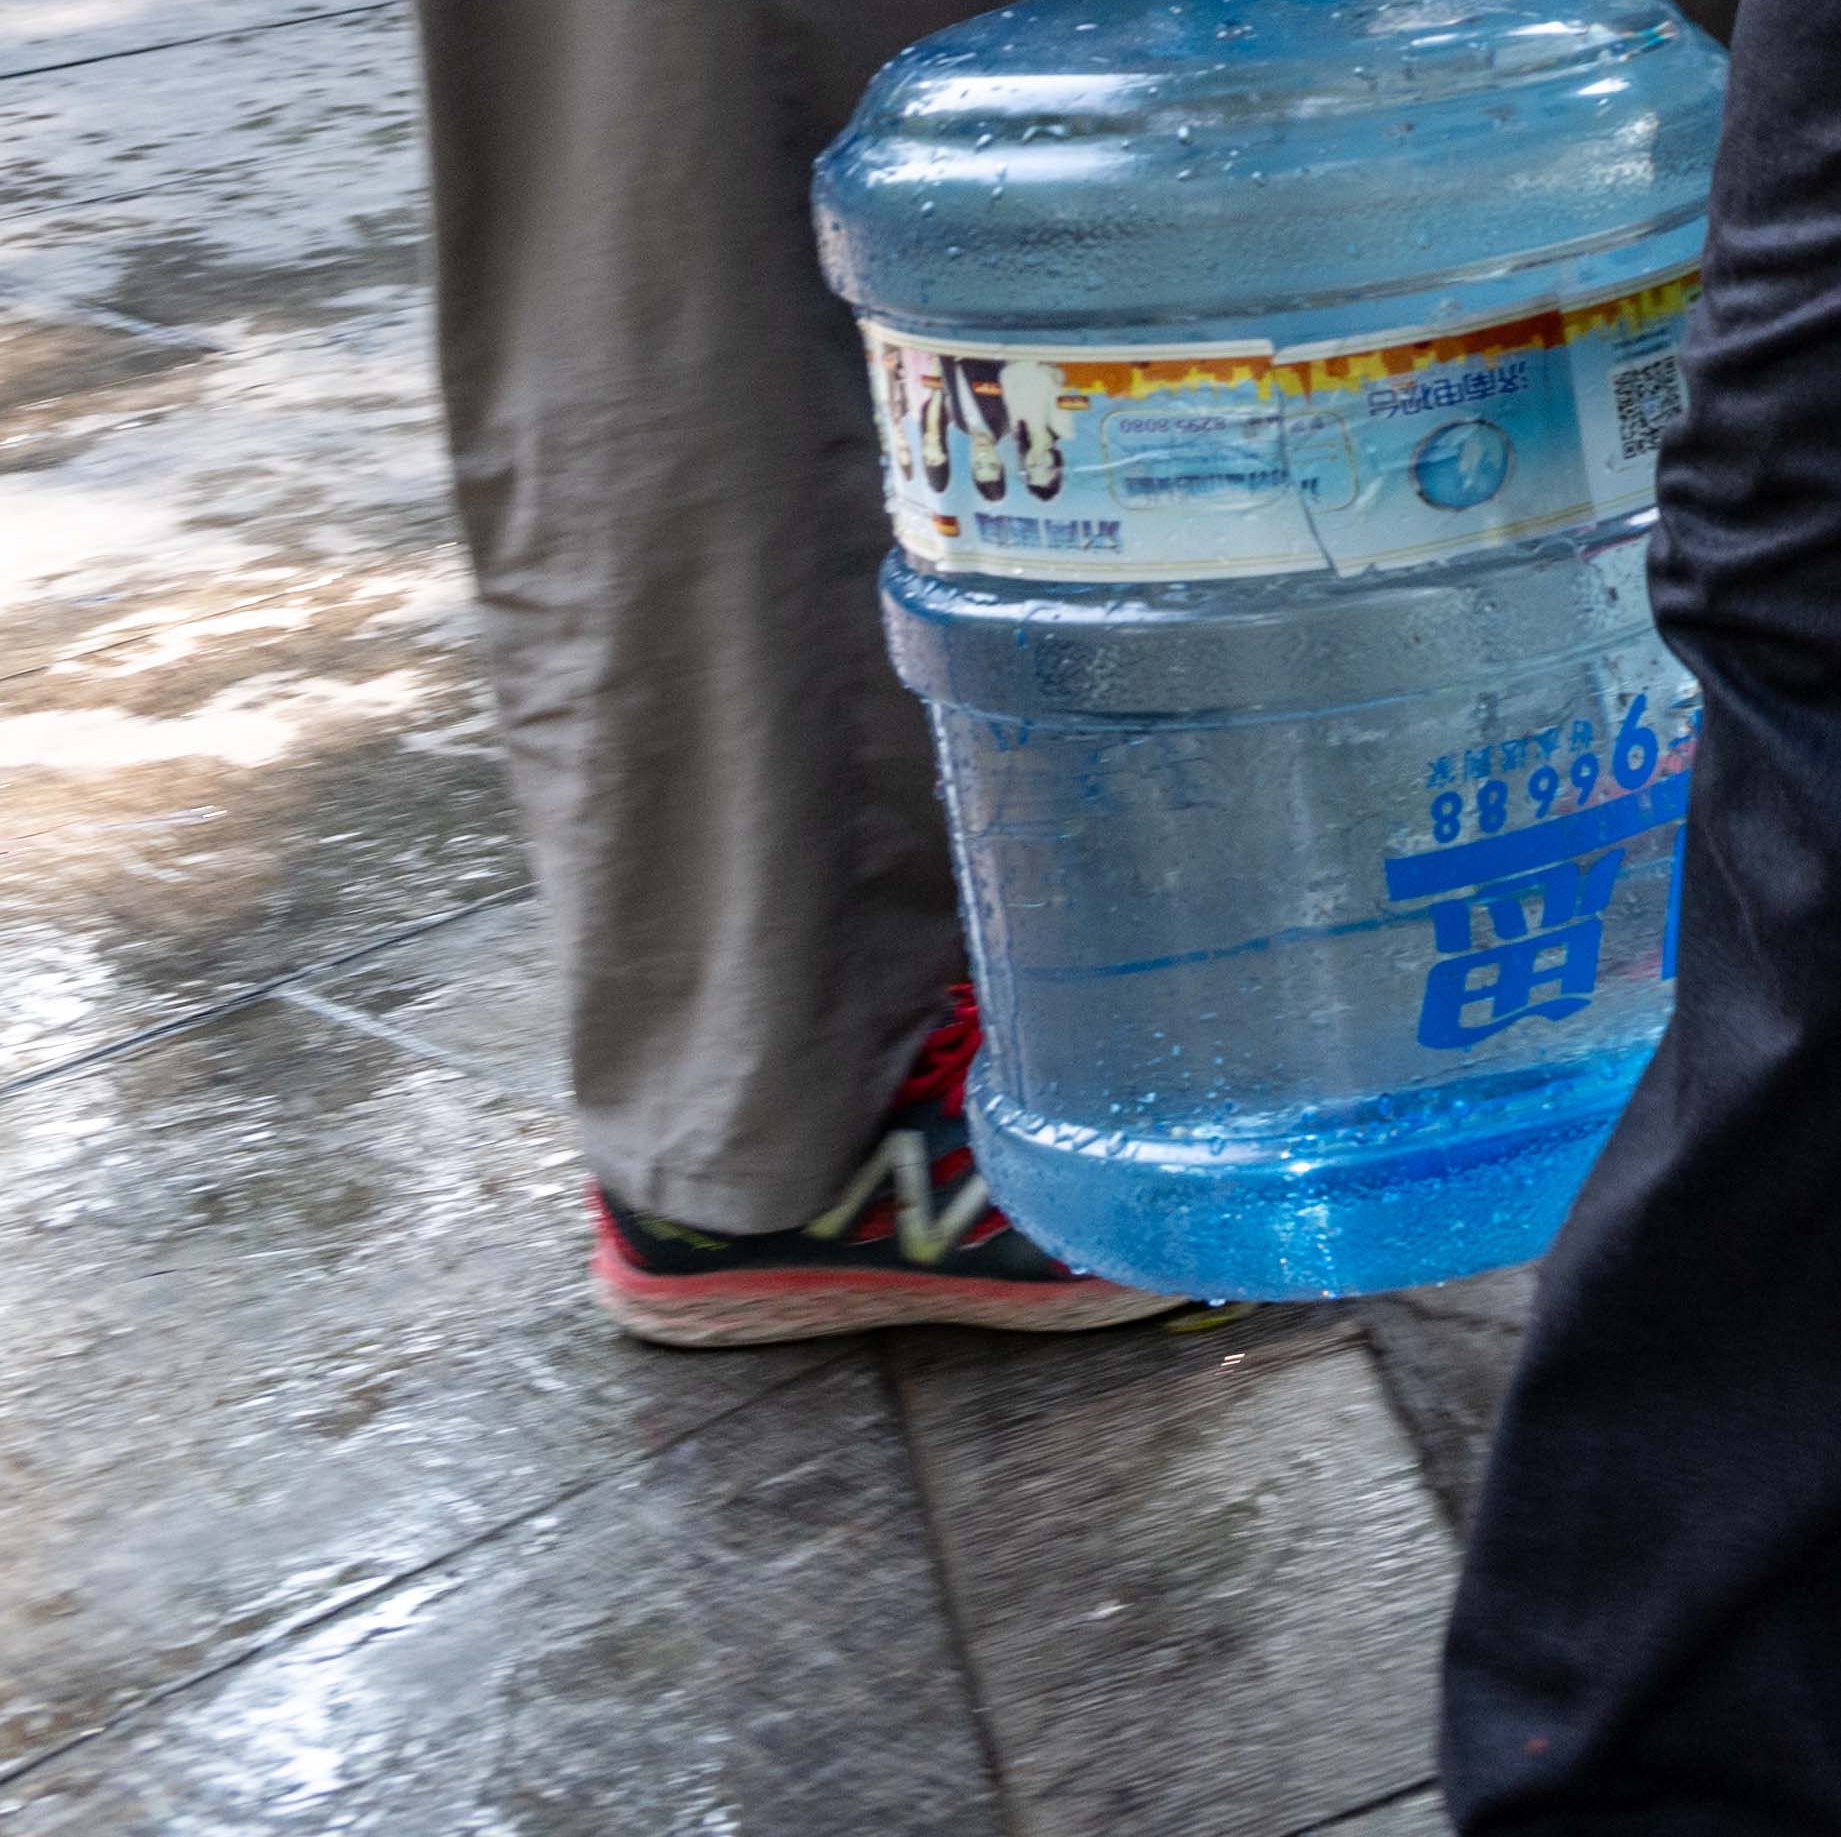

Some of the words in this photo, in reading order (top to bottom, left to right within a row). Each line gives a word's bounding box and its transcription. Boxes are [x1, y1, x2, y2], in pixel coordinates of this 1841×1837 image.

[1367, 362, 1528, 419] 济南电视台
[1430, 693, 1659, 844] 96688
